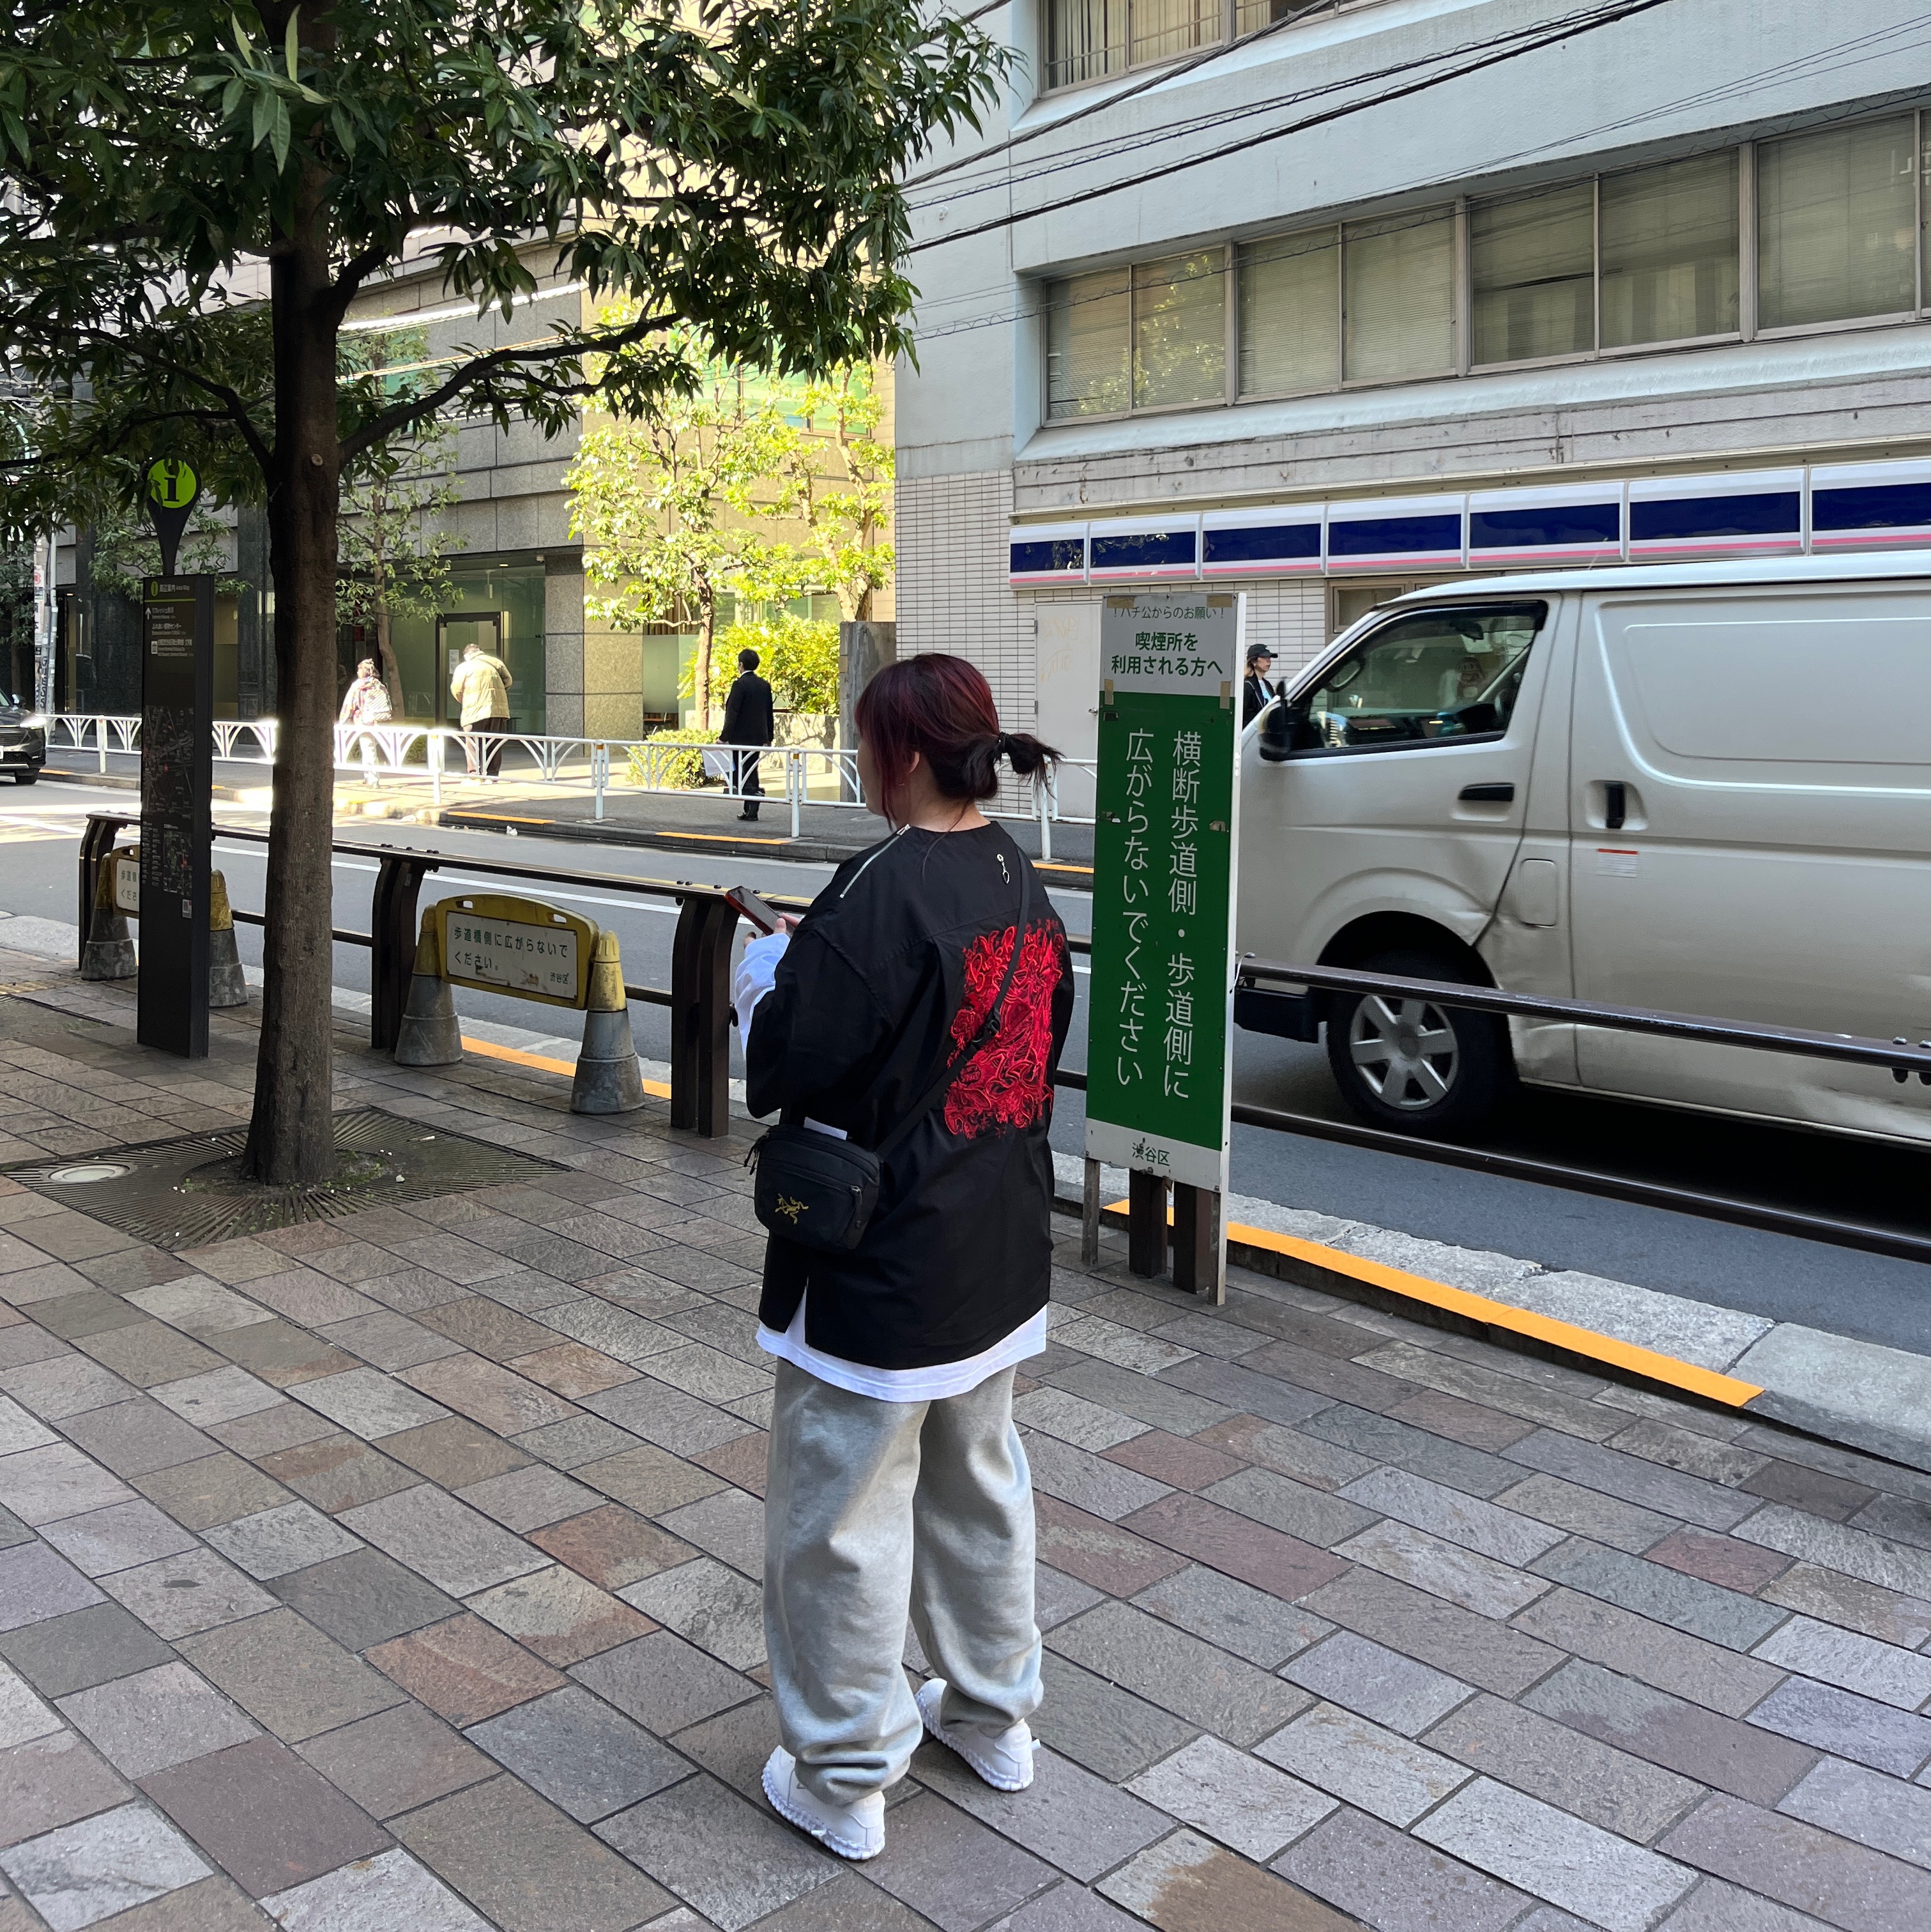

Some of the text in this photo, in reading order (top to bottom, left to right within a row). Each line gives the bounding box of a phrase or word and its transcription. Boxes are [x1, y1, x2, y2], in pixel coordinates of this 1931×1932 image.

[1135, 631, 1198, 652] 喫煙所を
[1111, 655, 1223, 677] 利用される方へ
[1117, 728, 1154, 1087] 広がらないでください
[1163, 730, 1202, 1099] 横断歩道側・歩道側に
[1132, 1142, 1170, 1166] 渋谷区
